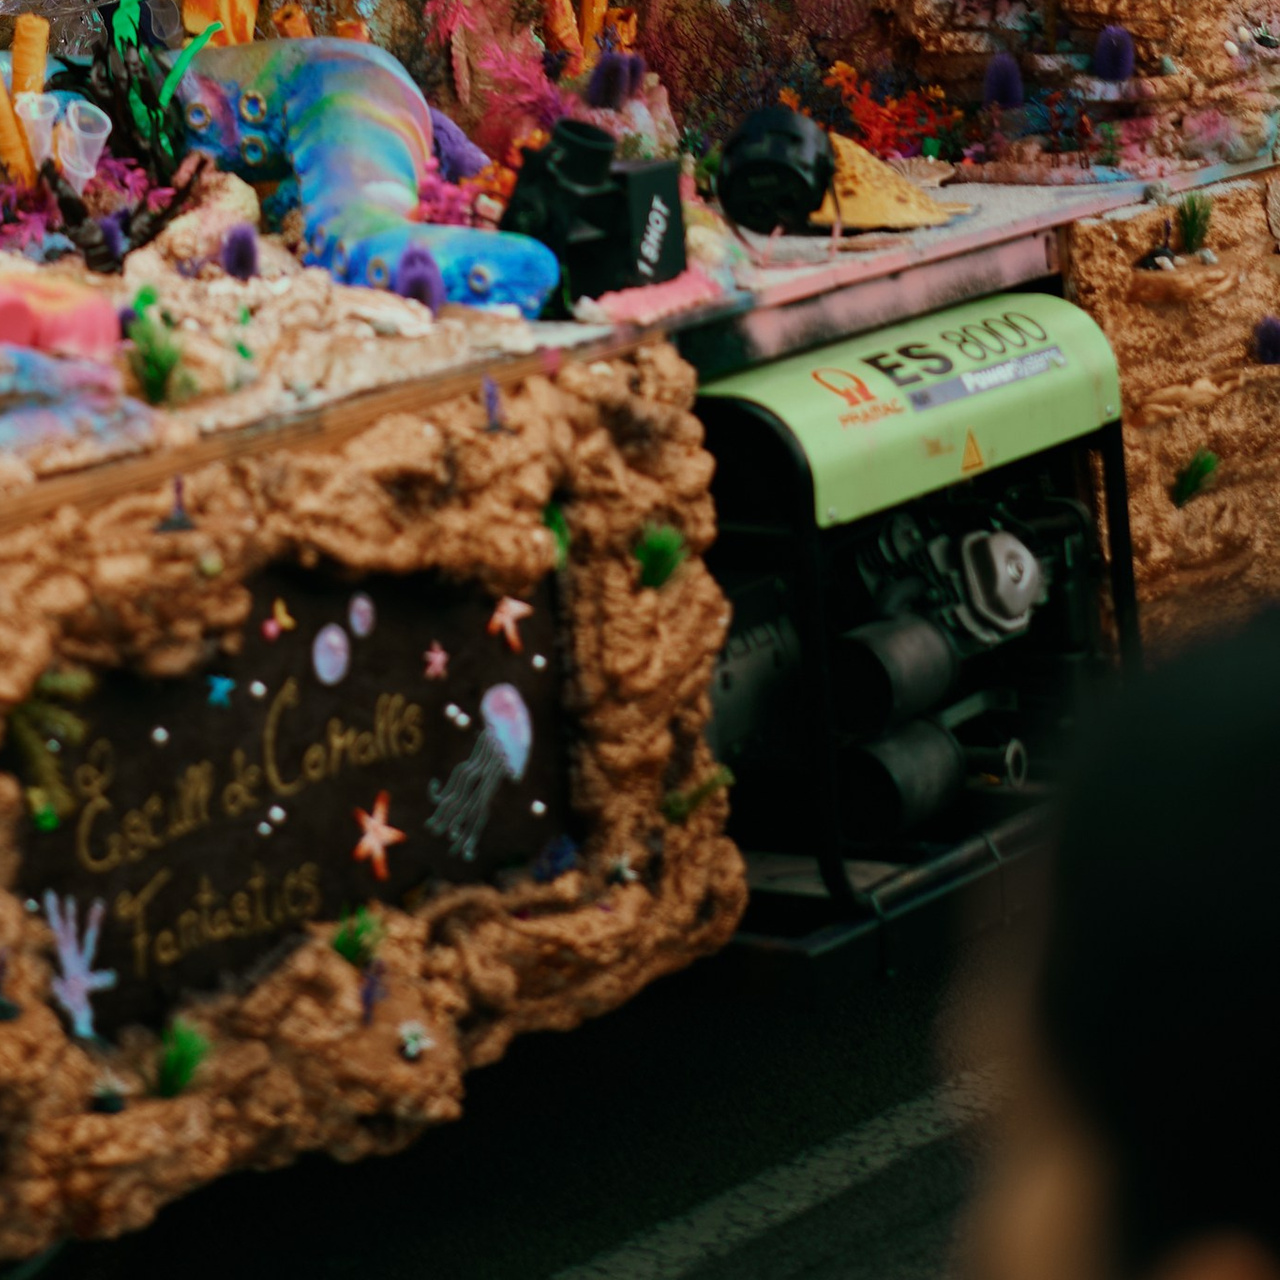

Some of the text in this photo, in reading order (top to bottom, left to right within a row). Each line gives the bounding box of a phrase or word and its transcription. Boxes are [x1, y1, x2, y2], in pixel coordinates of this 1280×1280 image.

[639, 194, 671, 264] SHOT
[860, 311, 1047, 386] ES 8000
